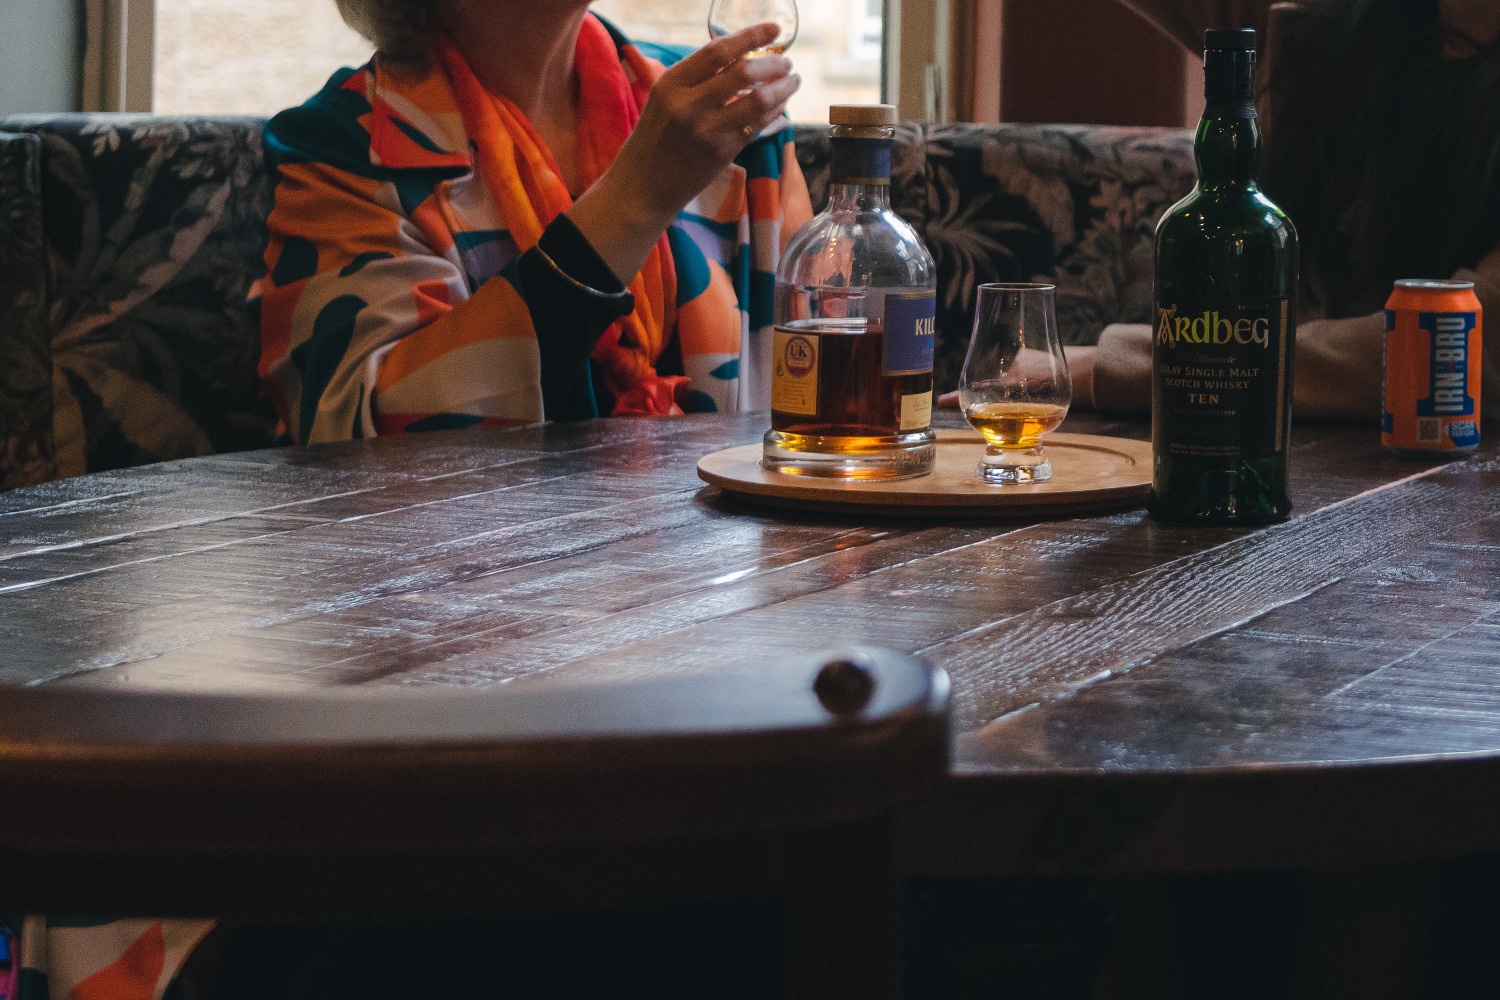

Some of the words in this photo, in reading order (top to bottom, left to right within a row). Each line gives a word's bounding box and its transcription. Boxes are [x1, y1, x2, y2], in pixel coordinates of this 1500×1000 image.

[1160, 363, 1182, 375] ISLAY
[1185, 366, 1225, 377] SINGLE
[1229, 368, 1259, 377] MALT
[1166, 377, 1200, 388] SCOTCH
[1204, 380, 1250, 389] WHISKY
[1189, 393, 1219, 404] TEN
